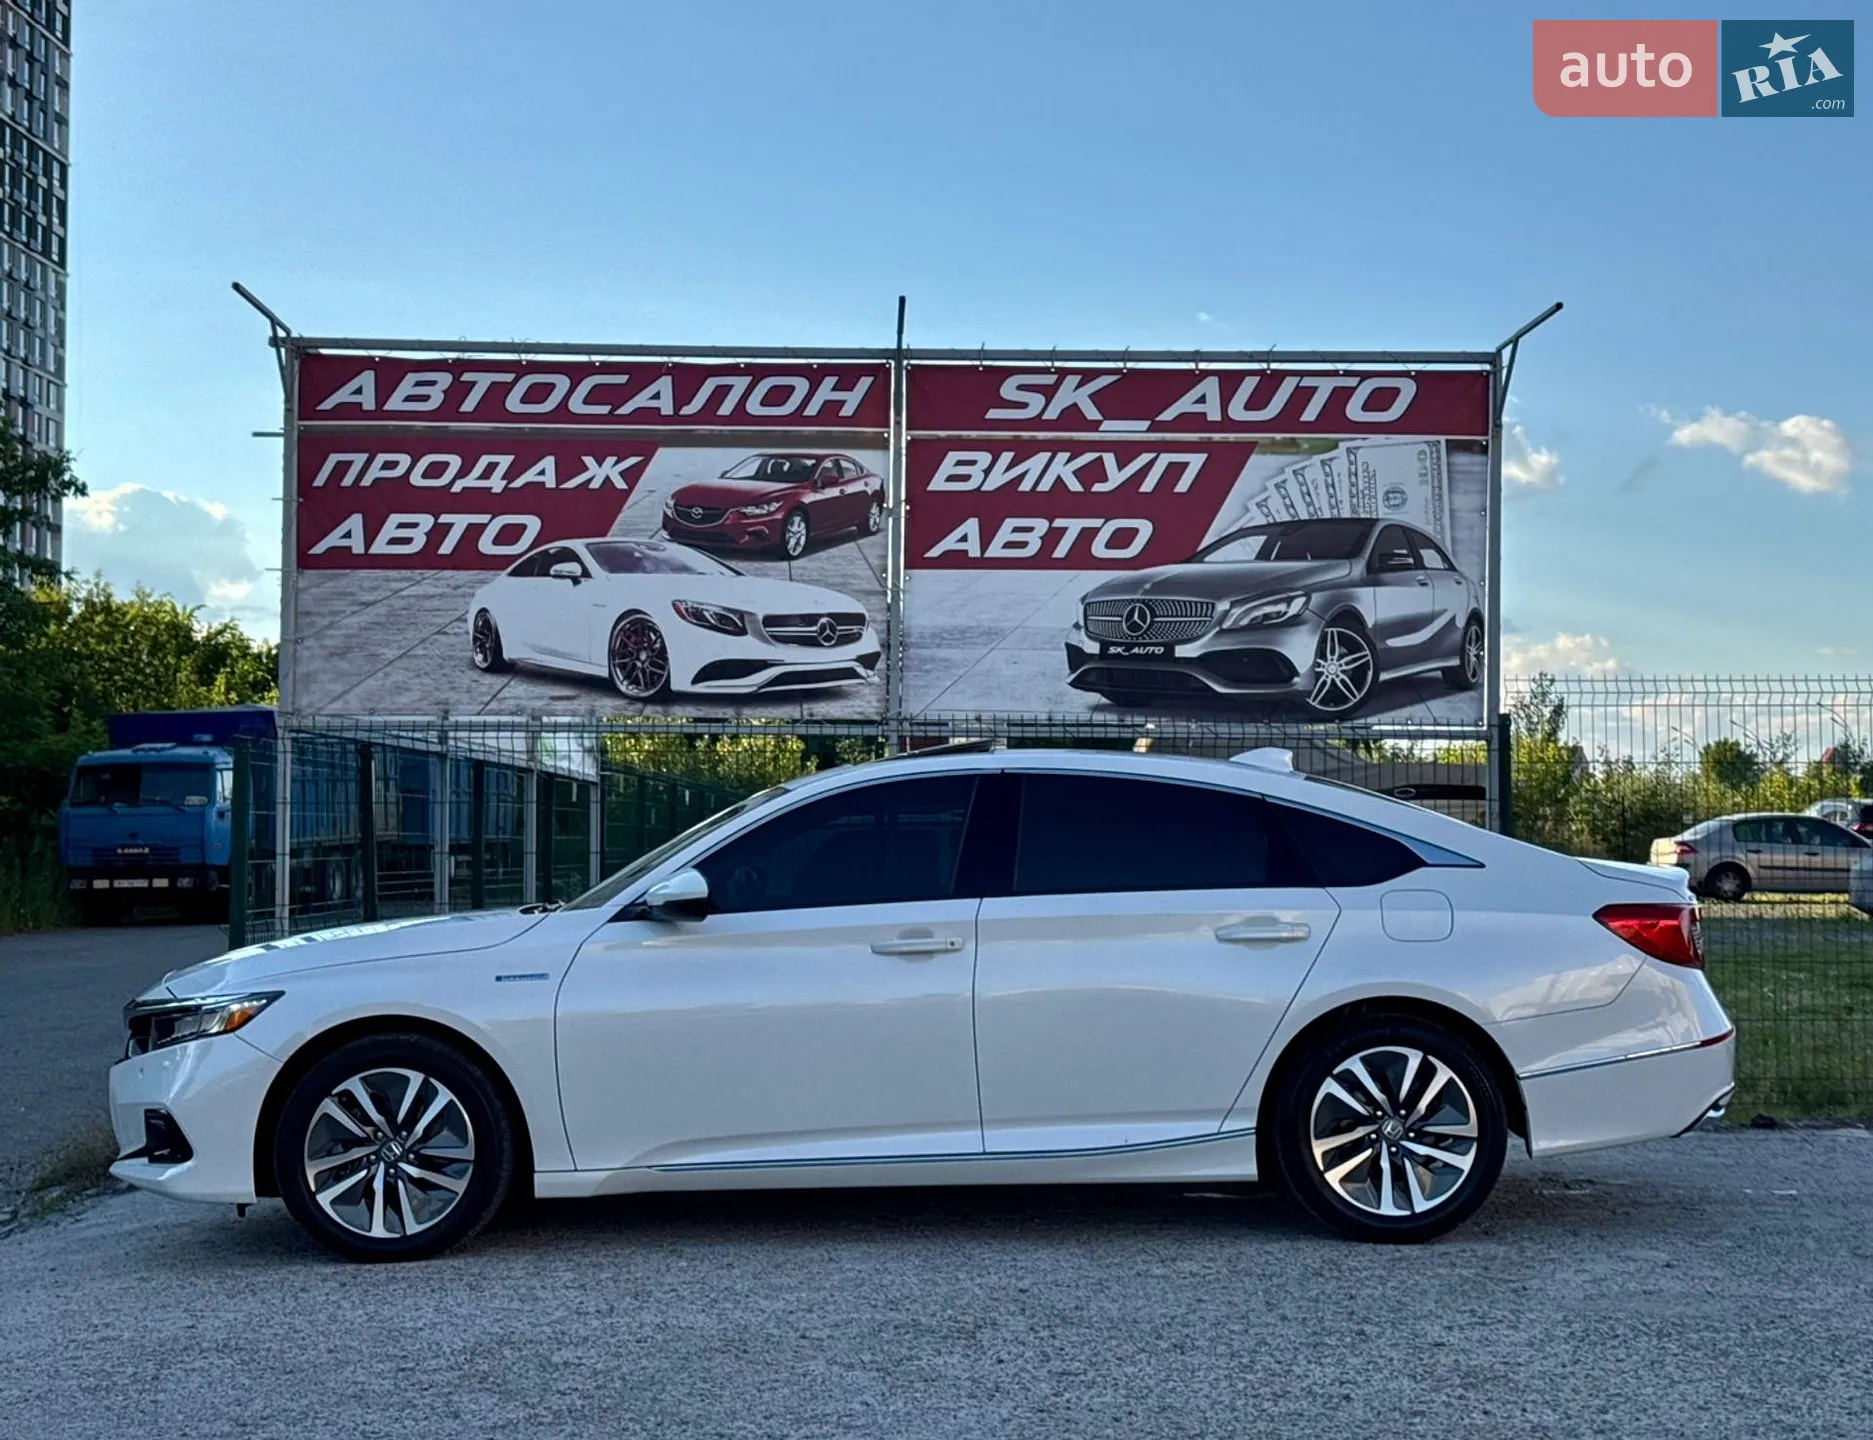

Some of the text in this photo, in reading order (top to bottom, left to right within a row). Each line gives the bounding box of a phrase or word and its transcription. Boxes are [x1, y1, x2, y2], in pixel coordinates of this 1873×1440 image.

[315, 369, 875, 417] АВТОСАЛОН
[984, 373, 1417, 432] SK_AUTO
[312, 453, 645, 494] ПРОДАЖ
[926, 450, 1209, 493] ВИКУП
[307, 513, 542, 555] АВТО
[923, 517, 1154, 559] АВТО
[1107, 646, 1165, 656] SK_AUTO
